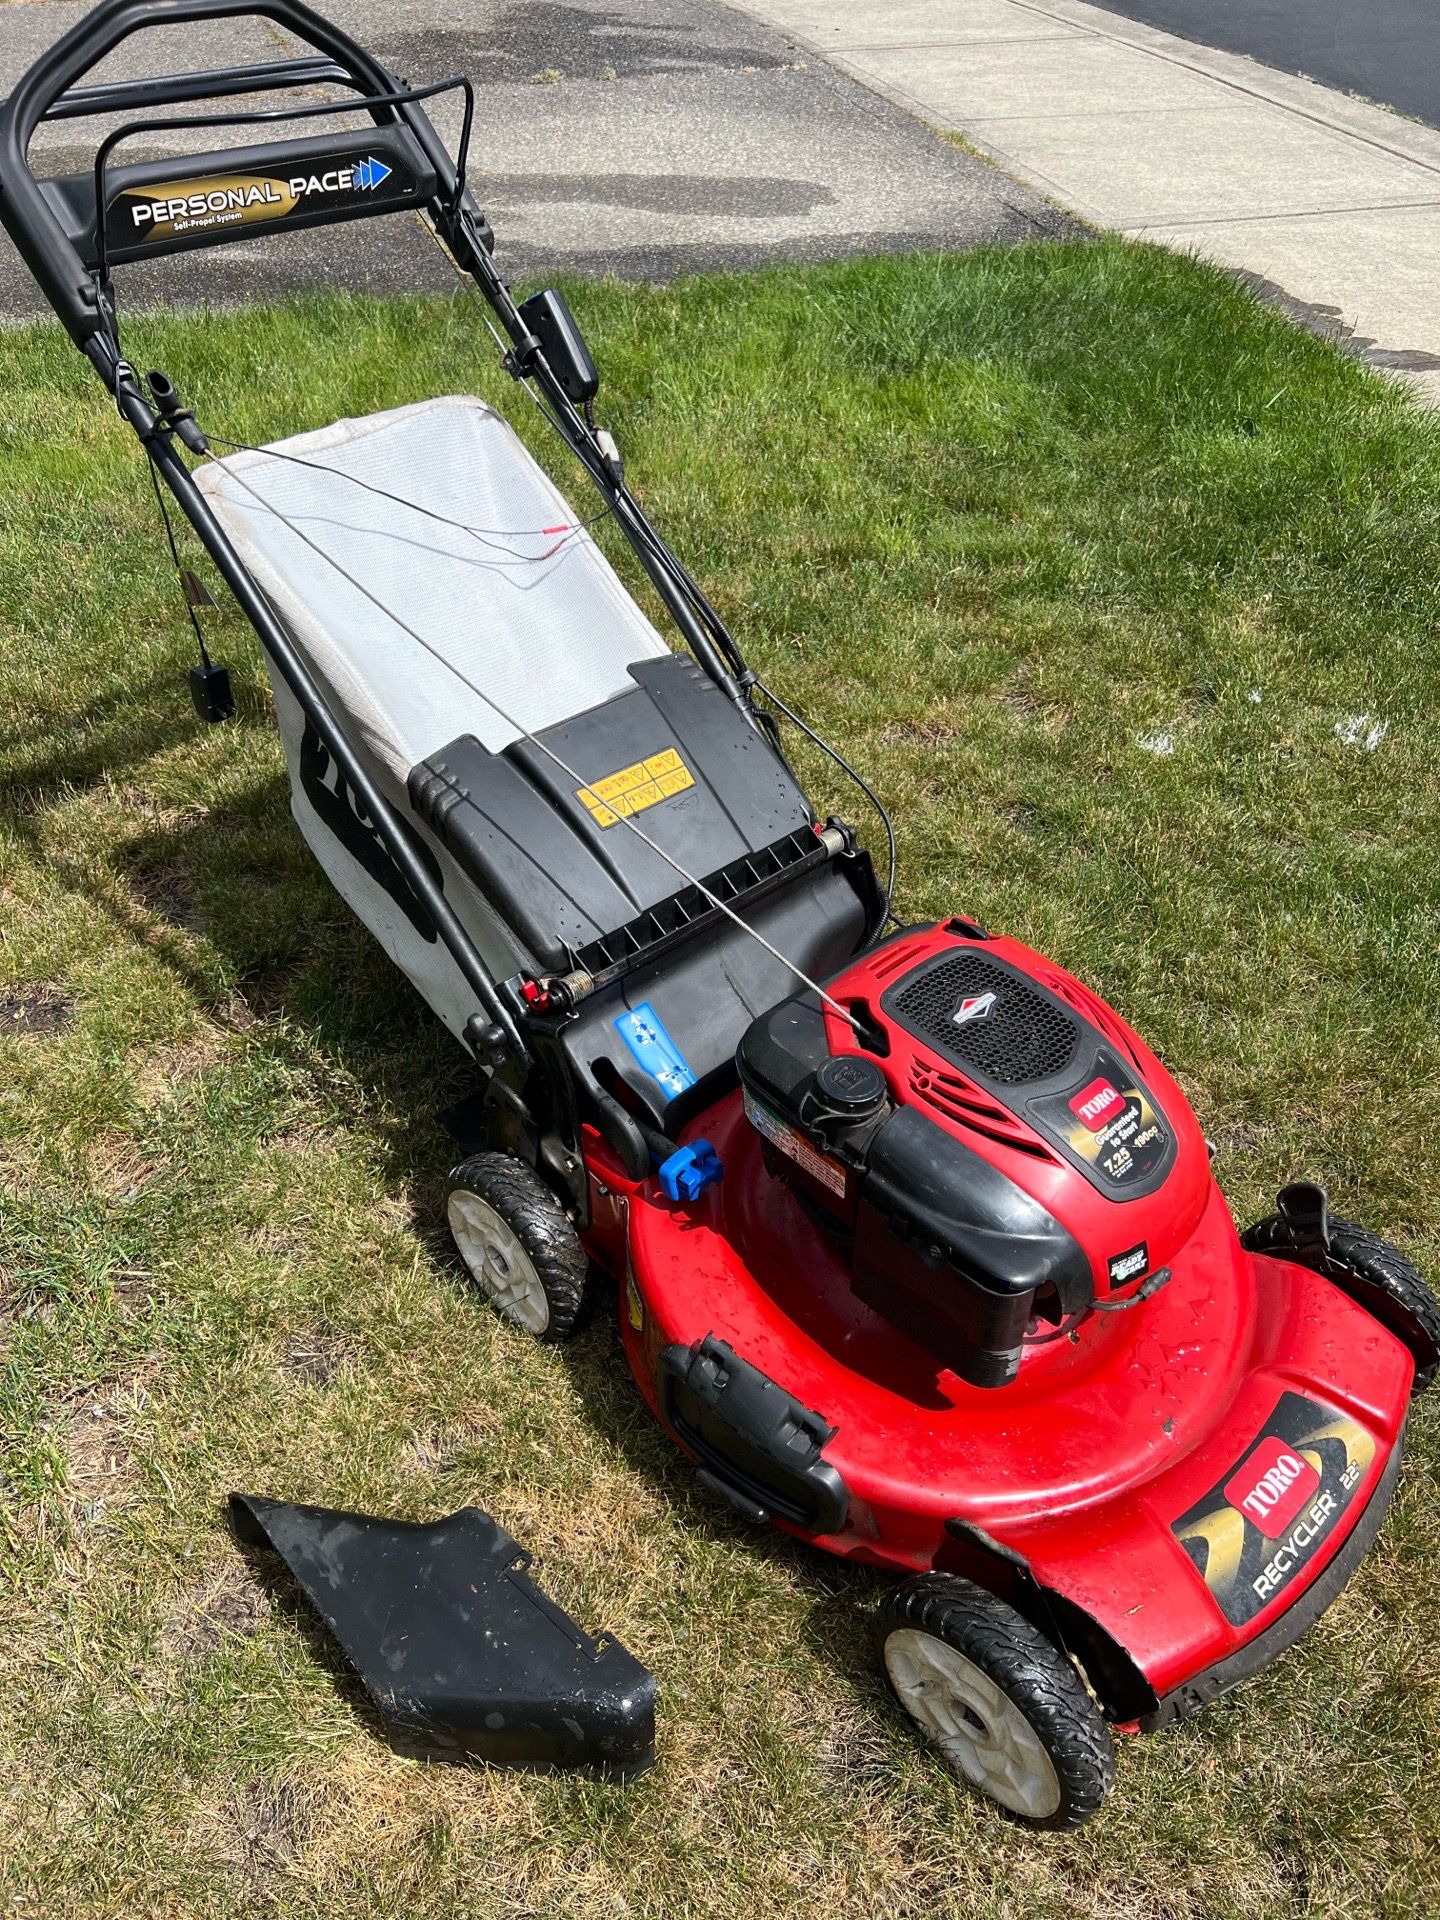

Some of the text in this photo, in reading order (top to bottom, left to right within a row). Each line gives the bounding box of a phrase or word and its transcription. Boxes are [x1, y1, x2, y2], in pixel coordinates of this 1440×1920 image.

[131, 168, 352, 226] PERSONAL PACE
[173, 211, 243, 231] Self-Propel System
[1078, 1087, 1116, 1121] TORO
[1095, 1105, 1140, 1146] Guaranteed
[1110, 1121, 1139, 1148] to Start
[1134, 1125, 1159, 1148] 190cc
[1103, 1147, 1131, 1173] 7.25
[1242, 1454, 1302, 1519] TORO
[1252, 1492, 1338, 1601] RECYCLER
